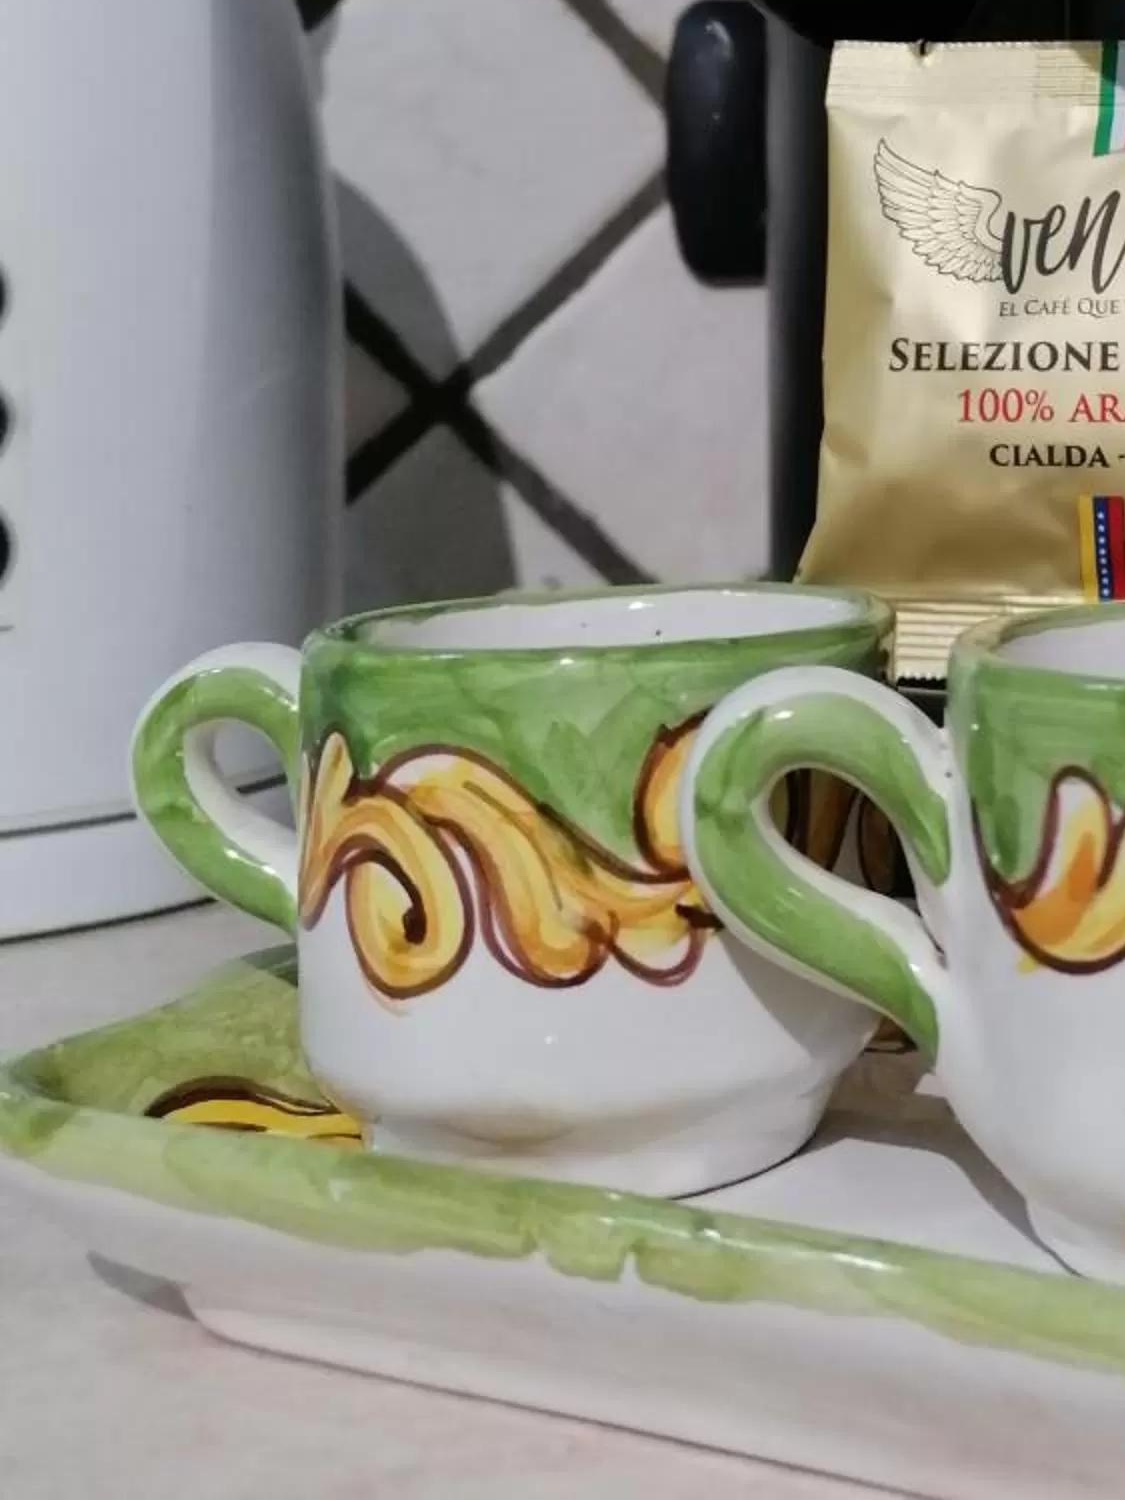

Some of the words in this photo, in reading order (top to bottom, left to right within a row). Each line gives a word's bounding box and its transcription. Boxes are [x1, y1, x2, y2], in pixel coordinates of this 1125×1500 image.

[999, 301, 1019, 318] EL
[1023, 297, 1071, 317] CAFÉ
[1077, 297, 1120, 319] QUE
[887, 337, 1121, 374] SELEZIONE
[957, 388, 1056, 424] 100%
[988, 443, 1111, 469] CIALDA
